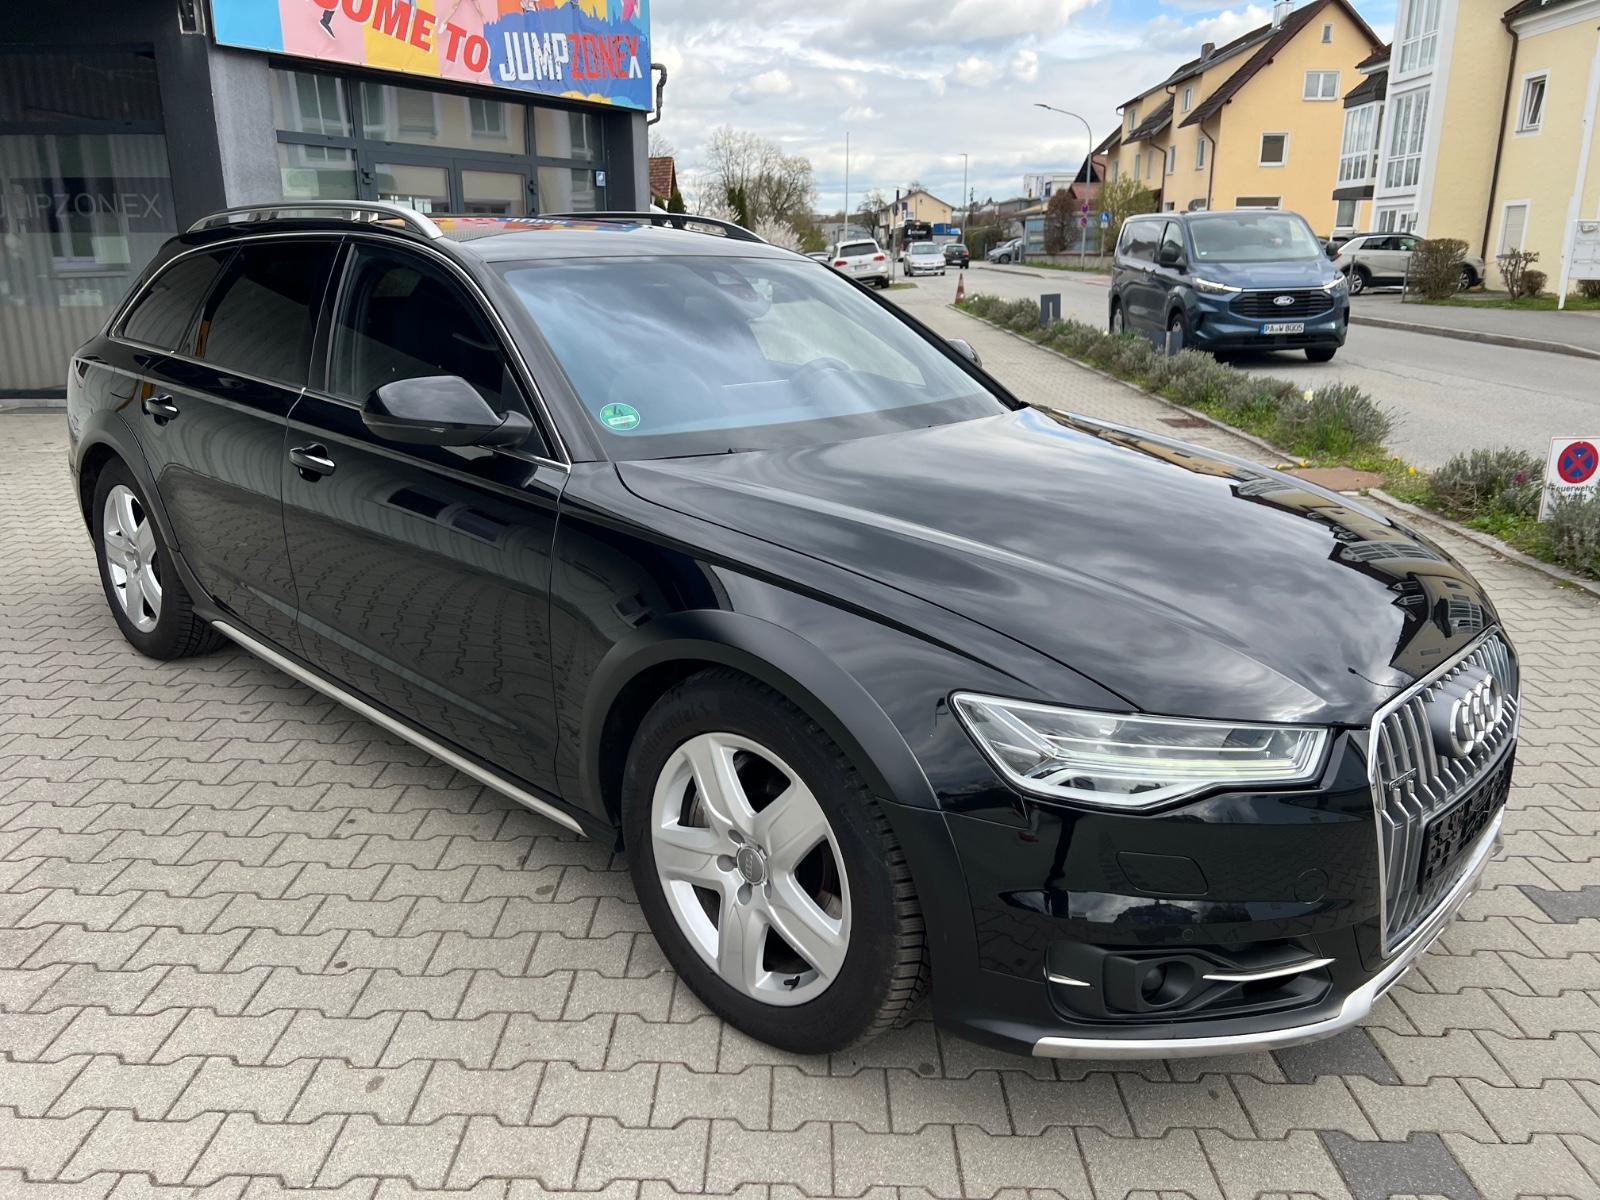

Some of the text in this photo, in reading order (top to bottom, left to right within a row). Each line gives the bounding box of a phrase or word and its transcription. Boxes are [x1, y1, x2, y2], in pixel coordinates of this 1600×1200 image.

[305, 0, 489, 73] OME TO
[498, 31, 643, 82] JUMPZONEX
